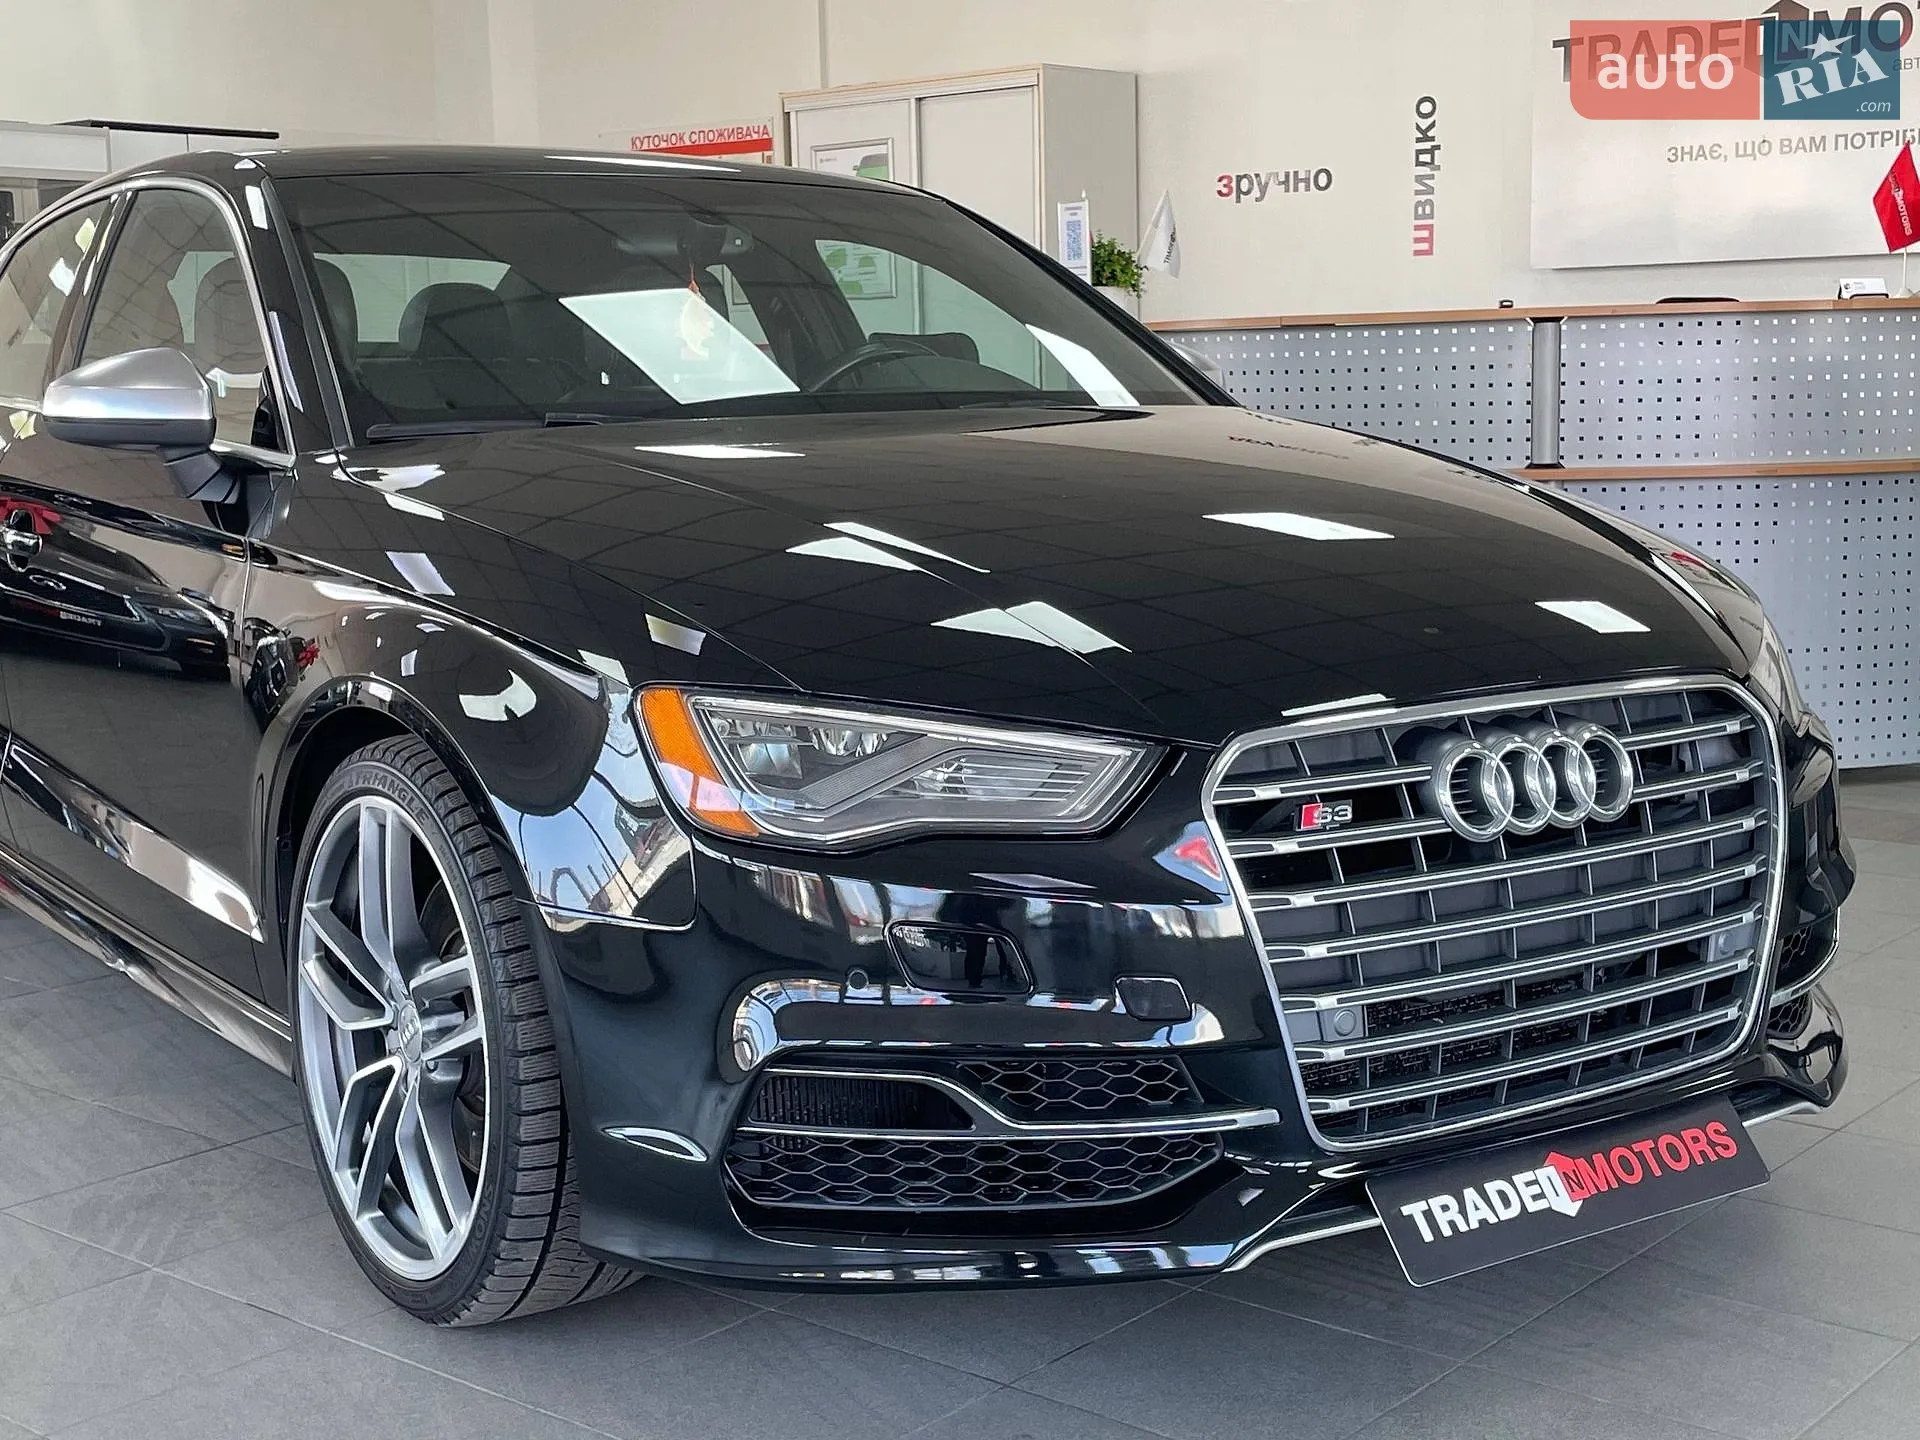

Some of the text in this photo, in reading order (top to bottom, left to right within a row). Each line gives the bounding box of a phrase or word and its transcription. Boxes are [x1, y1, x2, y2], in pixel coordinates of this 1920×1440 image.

[631, 124, 770, 150] КУТОЧОК СПОЖИВАЧА
[1666, 142, 1728, 163] ЗНАЄ,
[1734, 139, 1773, 161] ЩО
[1779, 135, 1827, 156] ВАМ
[1216, 167, 1333, 204] зручно
[1313, 805, 1353, 824] S3
